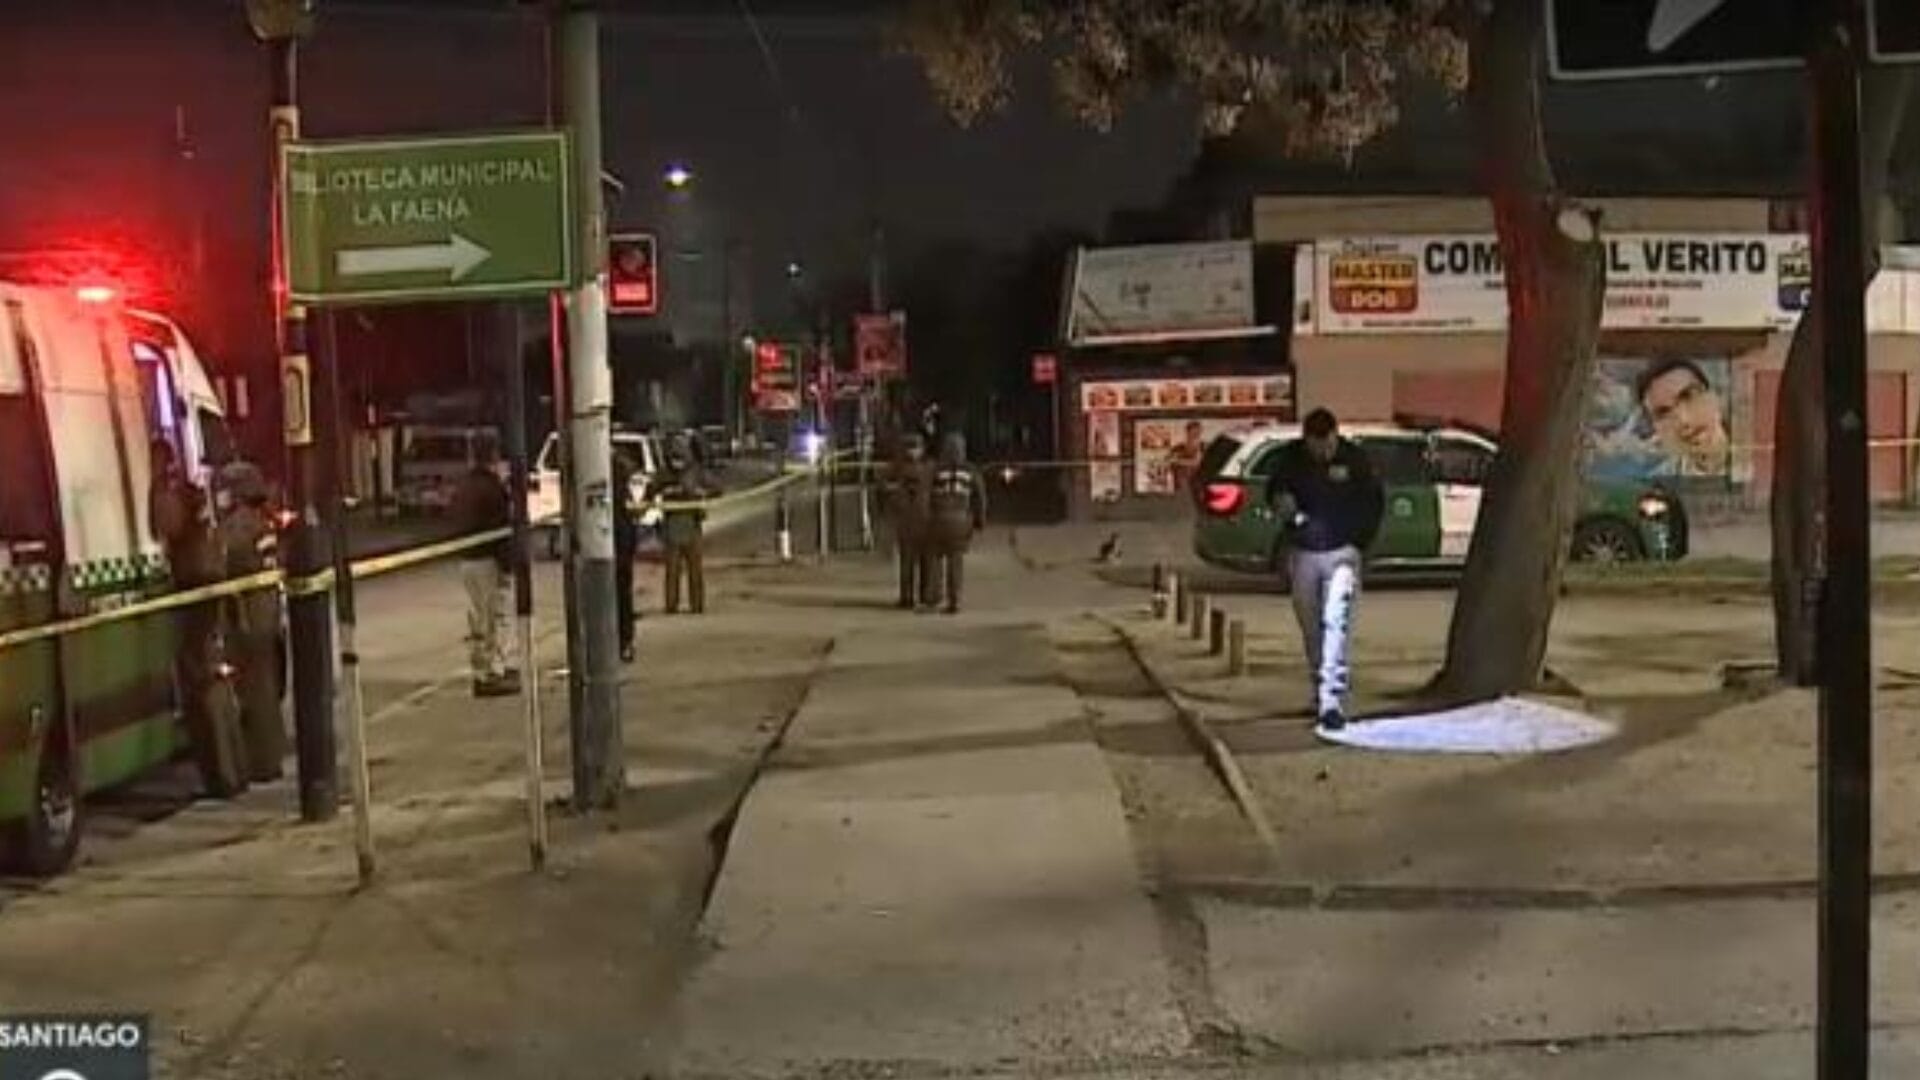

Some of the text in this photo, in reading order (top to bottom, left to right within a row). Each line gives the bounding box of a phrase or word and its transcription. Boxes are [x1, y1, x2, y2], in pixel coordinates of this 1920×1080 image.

[292, 158, 551, 193] LIOTECA MUNICIPAL
[354, 202, 384, 226] LA
[1642, 241, 1767, 274] VERITO
